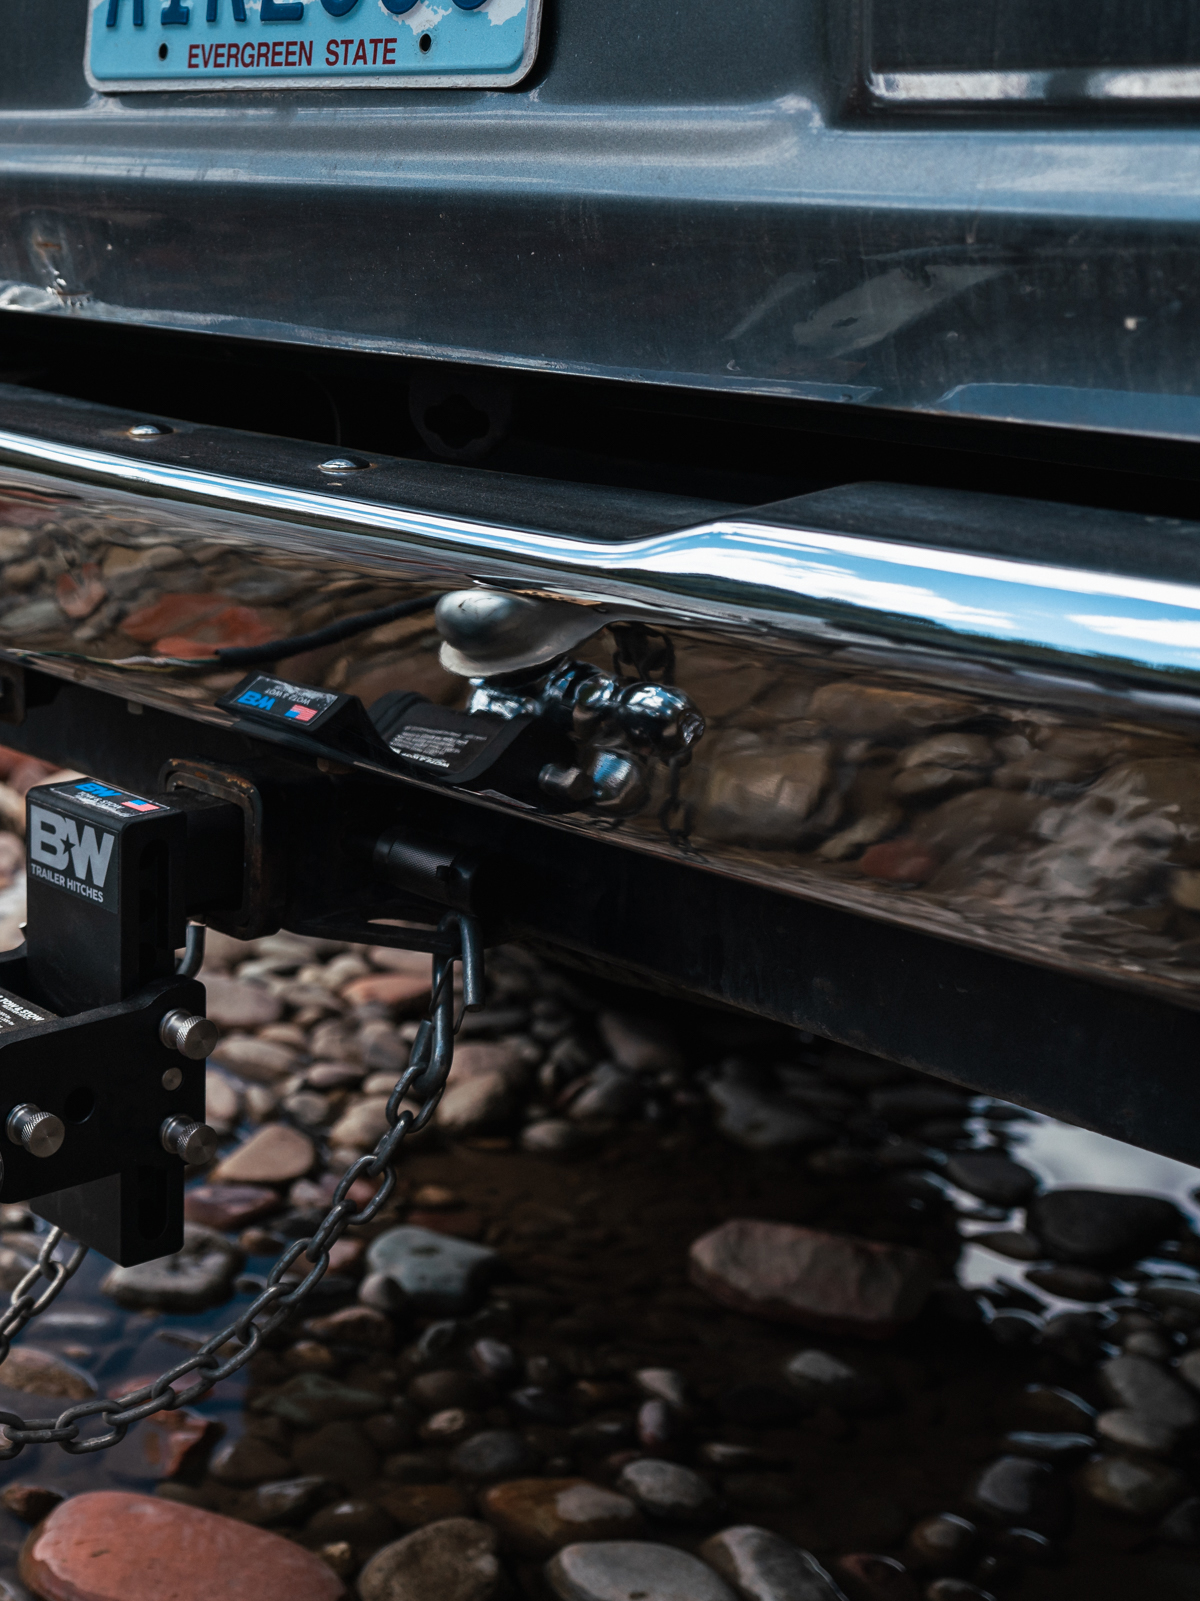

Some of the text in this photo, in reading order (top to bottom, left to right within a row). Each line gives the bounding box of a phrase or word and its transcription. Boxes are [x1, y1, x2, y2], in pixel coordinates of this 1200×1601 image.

[187, 38, 397, 69] EVERGREEN STATE
[31, 863, 104, 903] TRAILER HITCHES
[0, 997, 19, 1008] TOW
